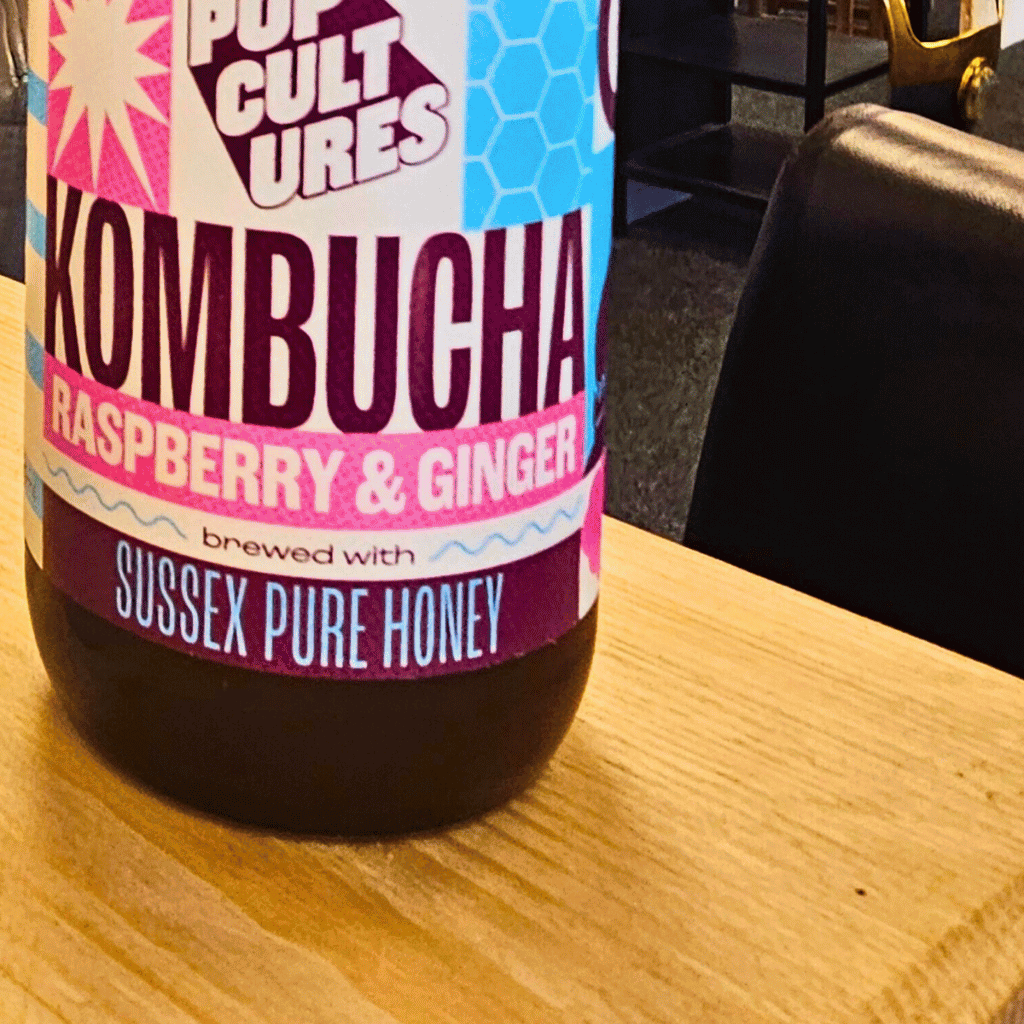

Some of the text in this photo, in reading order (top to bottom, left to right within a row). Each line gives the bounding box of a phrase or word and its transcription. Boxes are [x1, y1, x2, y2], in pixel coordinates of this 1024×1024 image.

[215, 15, 403, 138] CULT
[249, 82, 450, 210] URES
[44, 177, 585, 434] KOMBUCHA
[51, 372, 578, 516] RASPBERRY & GINGER
[114, 539, 505, 670] SUSSEX PURE HONEY
[202, 526, 416, 566] brewed with
